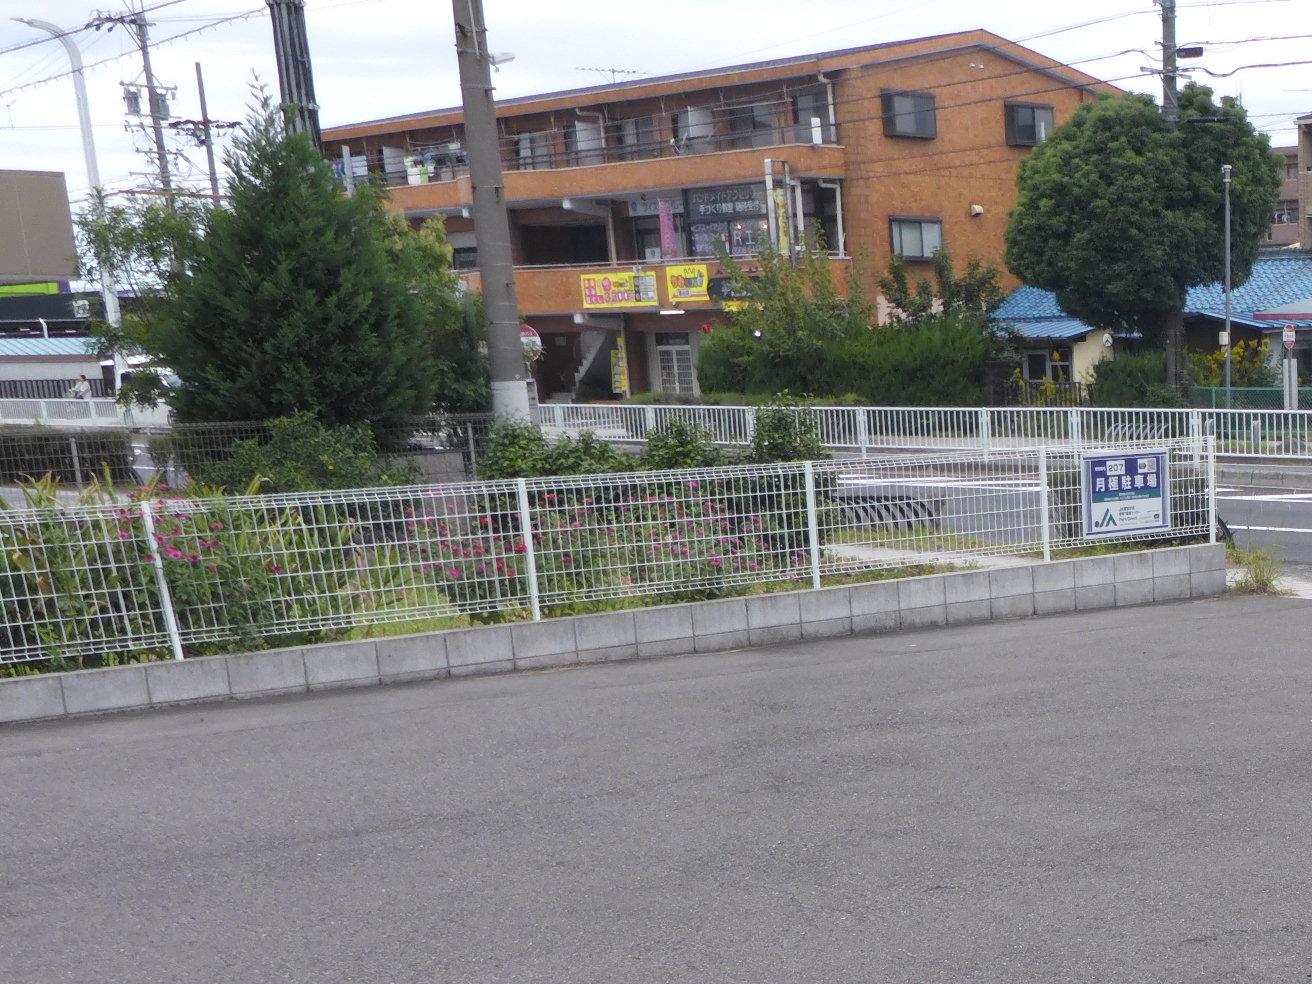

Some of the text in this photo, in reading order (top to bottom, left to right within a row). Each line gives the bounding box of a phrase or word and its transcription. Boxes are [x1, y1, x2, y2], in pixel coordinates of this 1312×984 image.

[1108, 463, 1124, 472] 207
[1095, 473, 1157, 492] 月極駐車場
